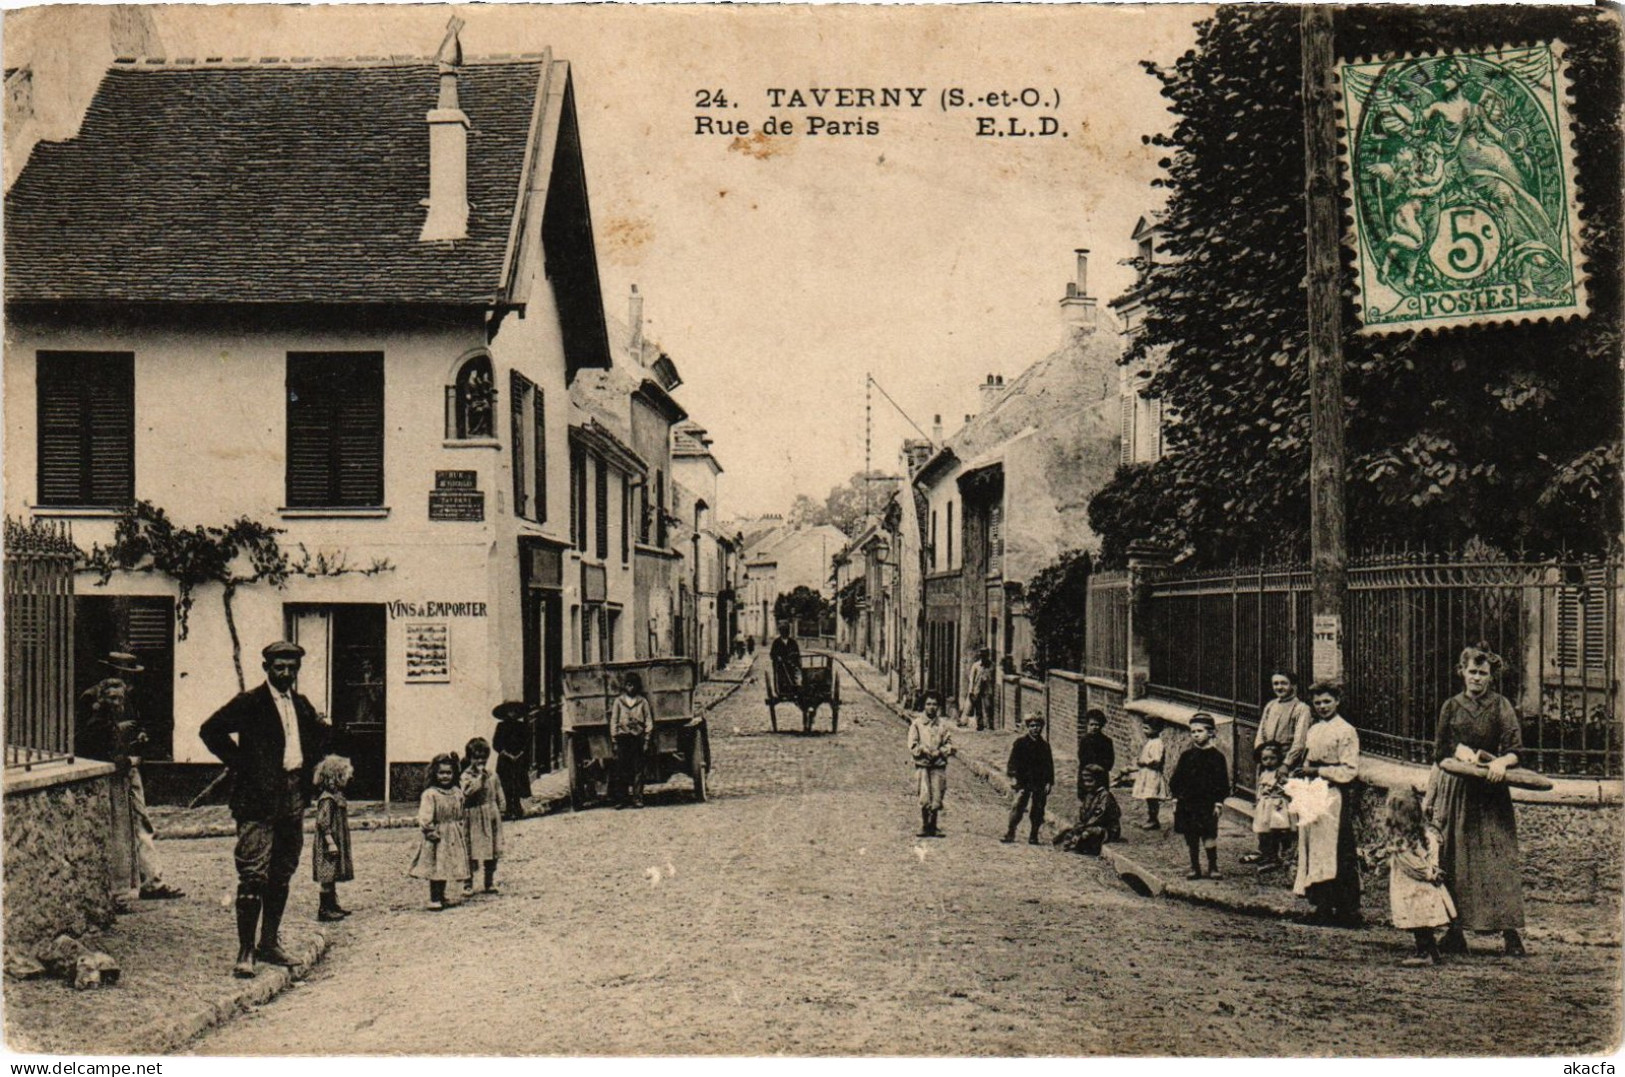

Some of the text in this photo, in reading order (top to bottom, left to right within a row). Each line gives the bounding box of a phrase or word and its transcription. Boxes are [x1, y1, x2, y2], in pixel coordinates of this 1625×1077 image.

[1421, 286, 1515, 317] POSTES
[387, 599, 417, 620] VINS
[426, 601, 488, 618] EMPORTER
